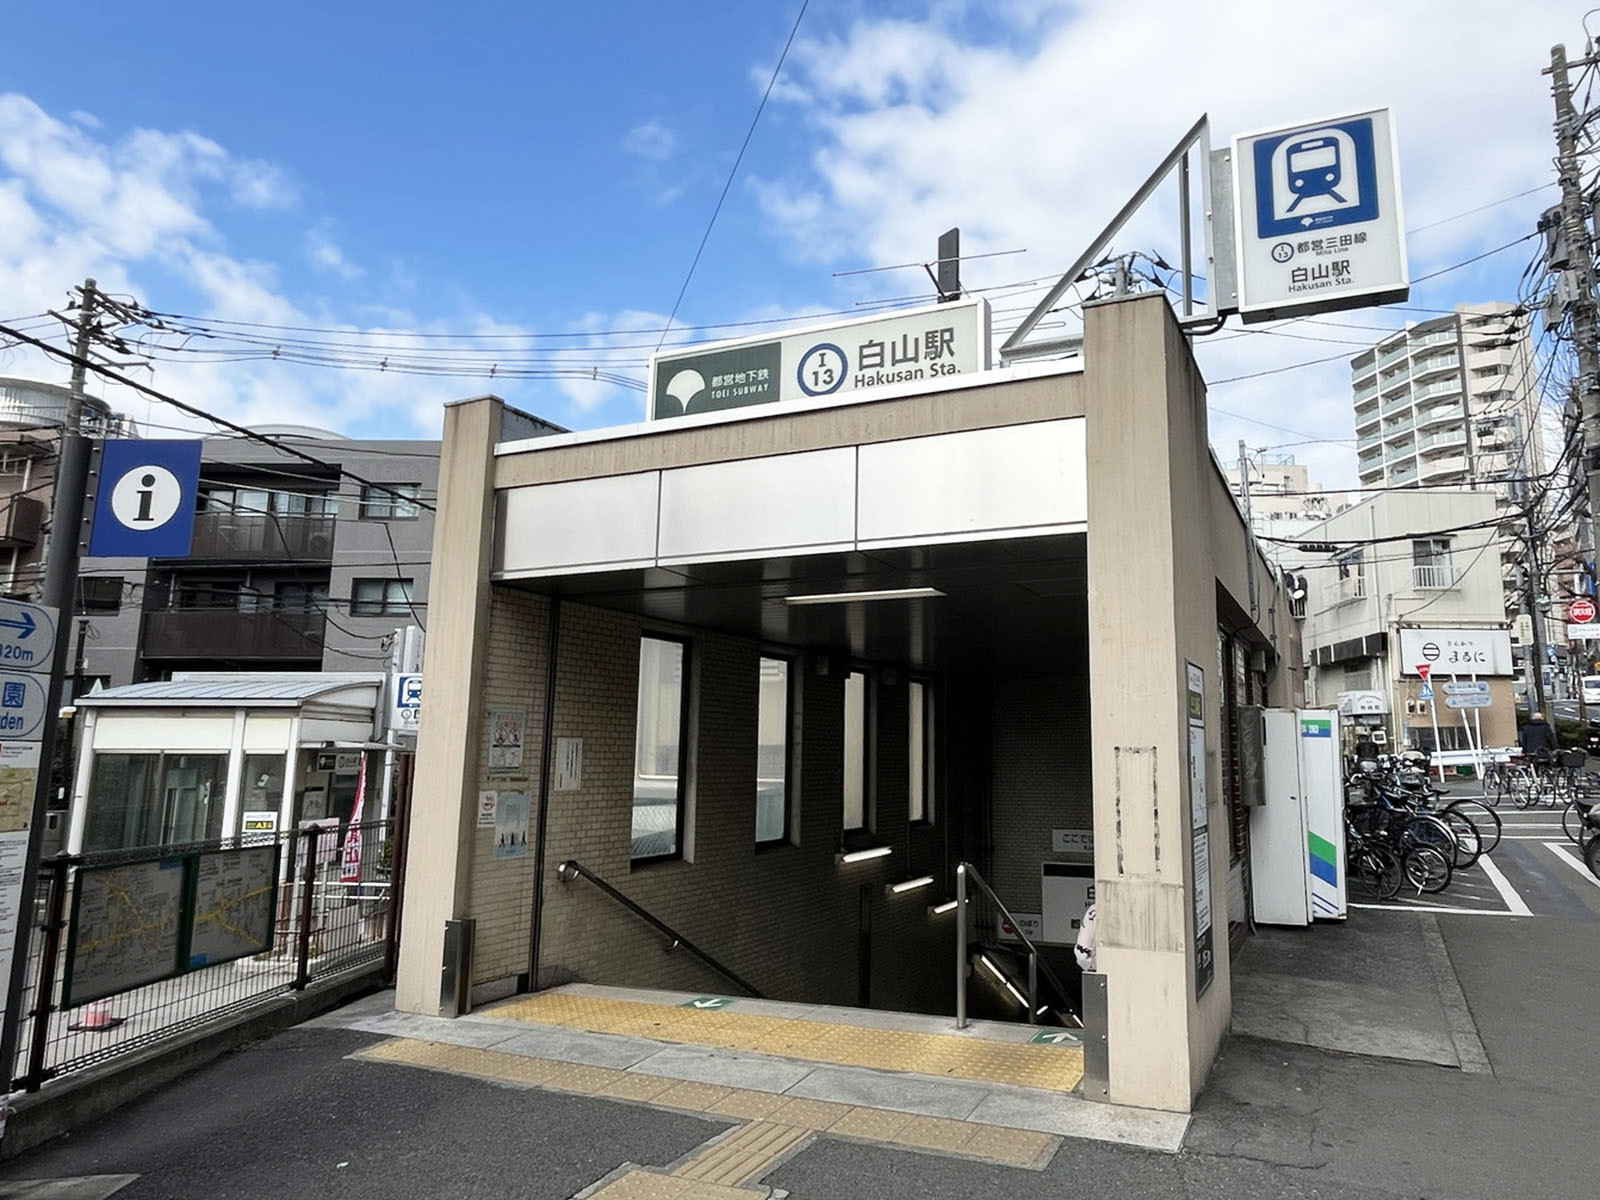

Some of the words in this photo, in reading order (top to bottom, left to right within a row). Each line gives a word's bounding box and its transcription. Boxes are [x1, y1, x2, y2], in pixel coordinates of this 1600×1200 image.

[1297, 232, 1367, 253] 都営三田線
[1333, 246, 1349, 254] Line
[1291, 259, 1351, 283] 白山駅
[1288, 279, 1332, 293] Hakusan
[1335, 276, 1355, 286] Sta.
[857, 327, 956, 372] 白山駅
[711, 368, 769, 388] 都営地下鉄
[812, 369, 835, 387] 13
[854, 367, 924, 389] Hakusan
[929, 362, 962, 378] Sta.
[711, 388, 731, 400] TOEI
[731, 382, 770, 398] SUBWAY
[1448, 650, 1486, 664] まるに
